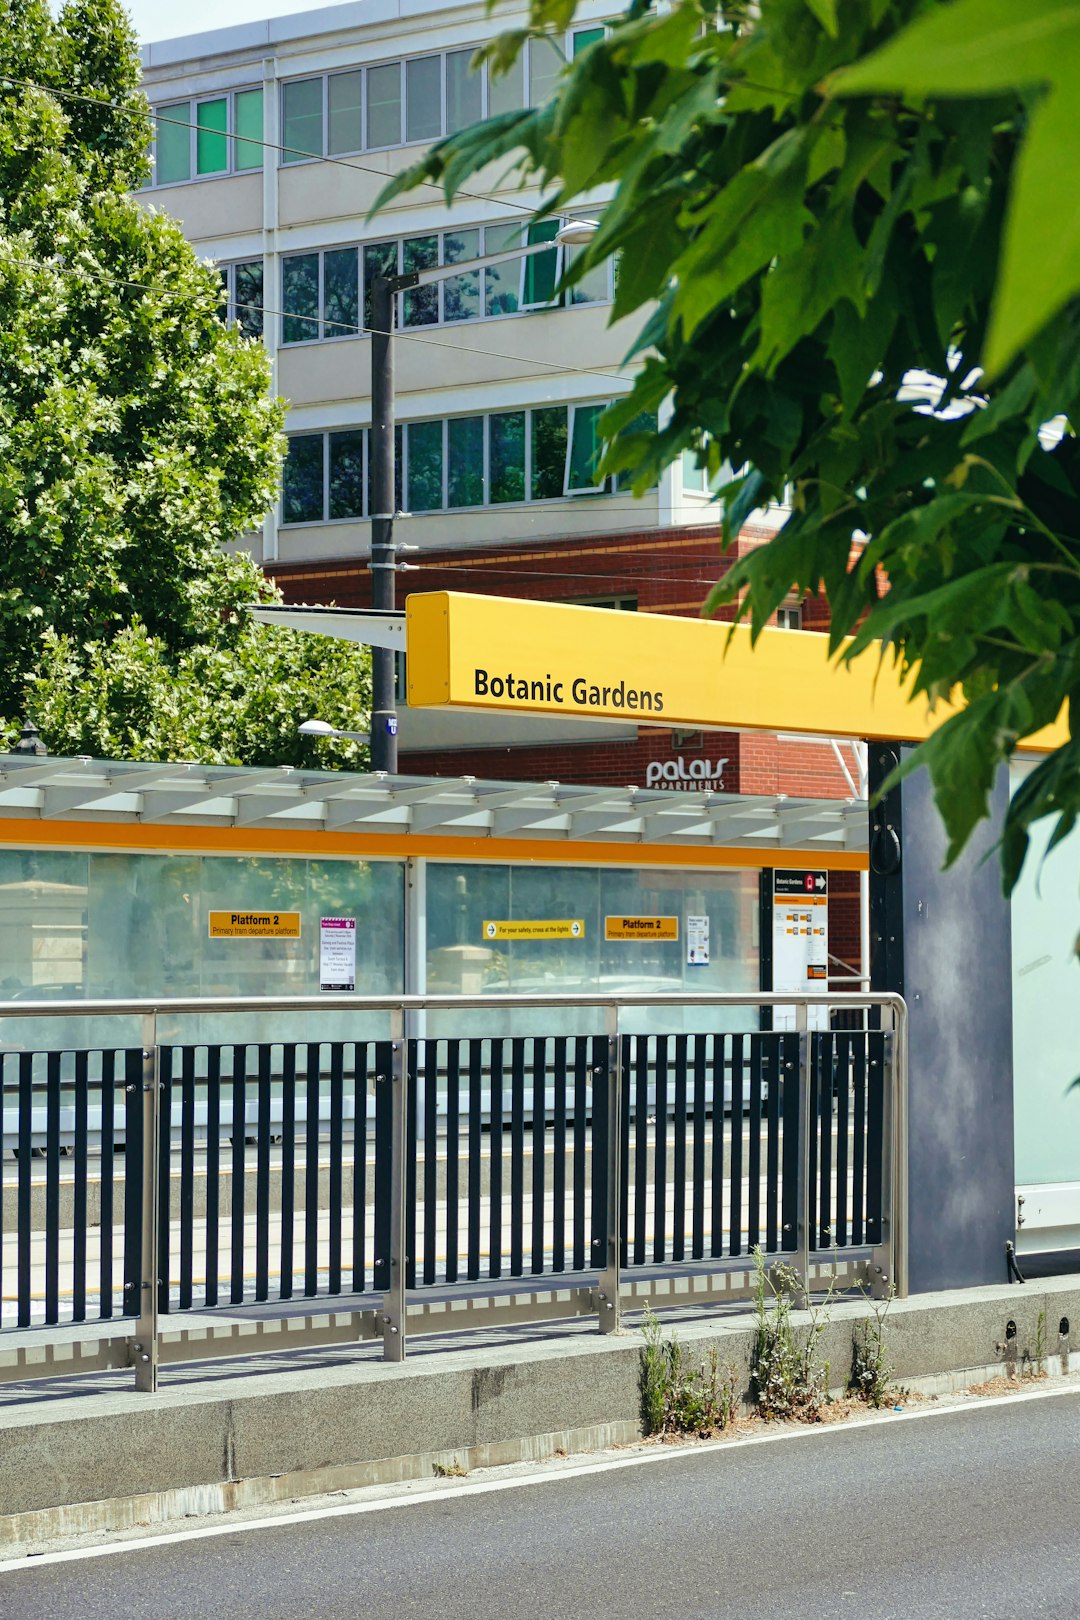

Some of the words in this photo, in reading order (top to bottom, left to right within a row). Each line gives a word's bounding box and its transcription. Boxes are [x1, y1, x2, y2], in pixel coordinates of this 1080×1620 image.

[474, 669, 564, 703] Botanic
[571, 678, 664, 712] Gardens
[654, 779, 725, 791] APARTMENTS
[231, 914, 270, 925] Platform
[273, 915, 279, 925] 2
[623, 920, 654, 929] Platform
[656, 920, 661, 929] 2
[212, 926, 233, 935] Primary
[248, 927, 274, 935] departure
[275, 927, 297, 935] platform
[518, 926, 531, 934] safety,
[608, 930, 625, 938] Primary
